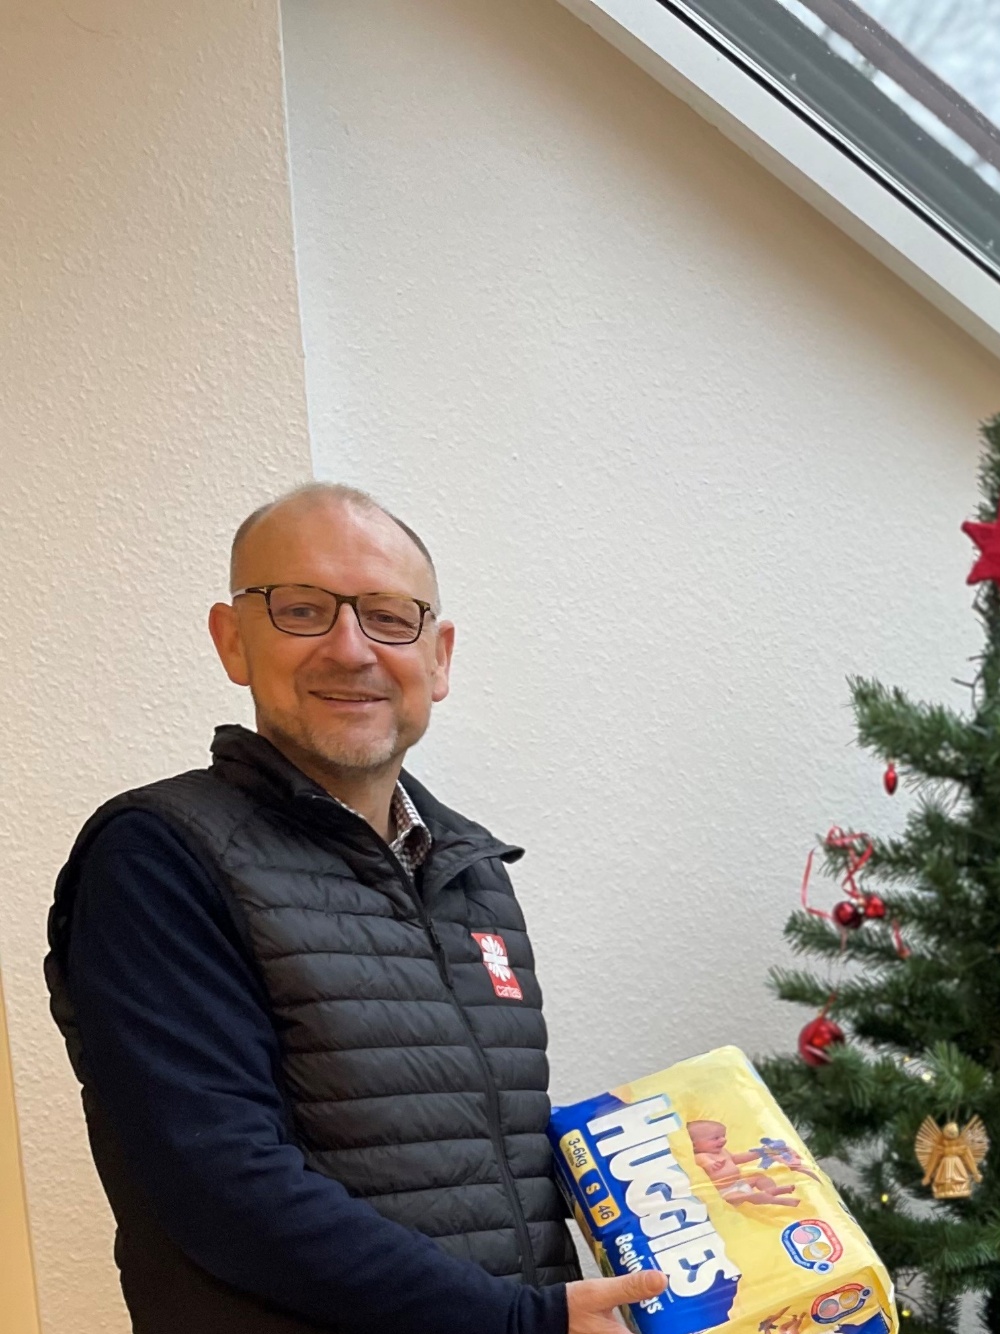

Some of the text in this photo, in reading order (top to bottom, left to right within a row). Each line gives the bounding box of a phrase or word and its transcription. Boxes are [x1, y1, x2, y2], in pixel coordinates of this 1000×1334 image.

[568, 1138, 587, 1168] 3-6kg
[586, 1182, 600, 1196] S
[597, 1205, 614, 1220] 46
[586, 1093, 741, 1298] HUGGIES
[615, 1232, 663, 1314] Begings
